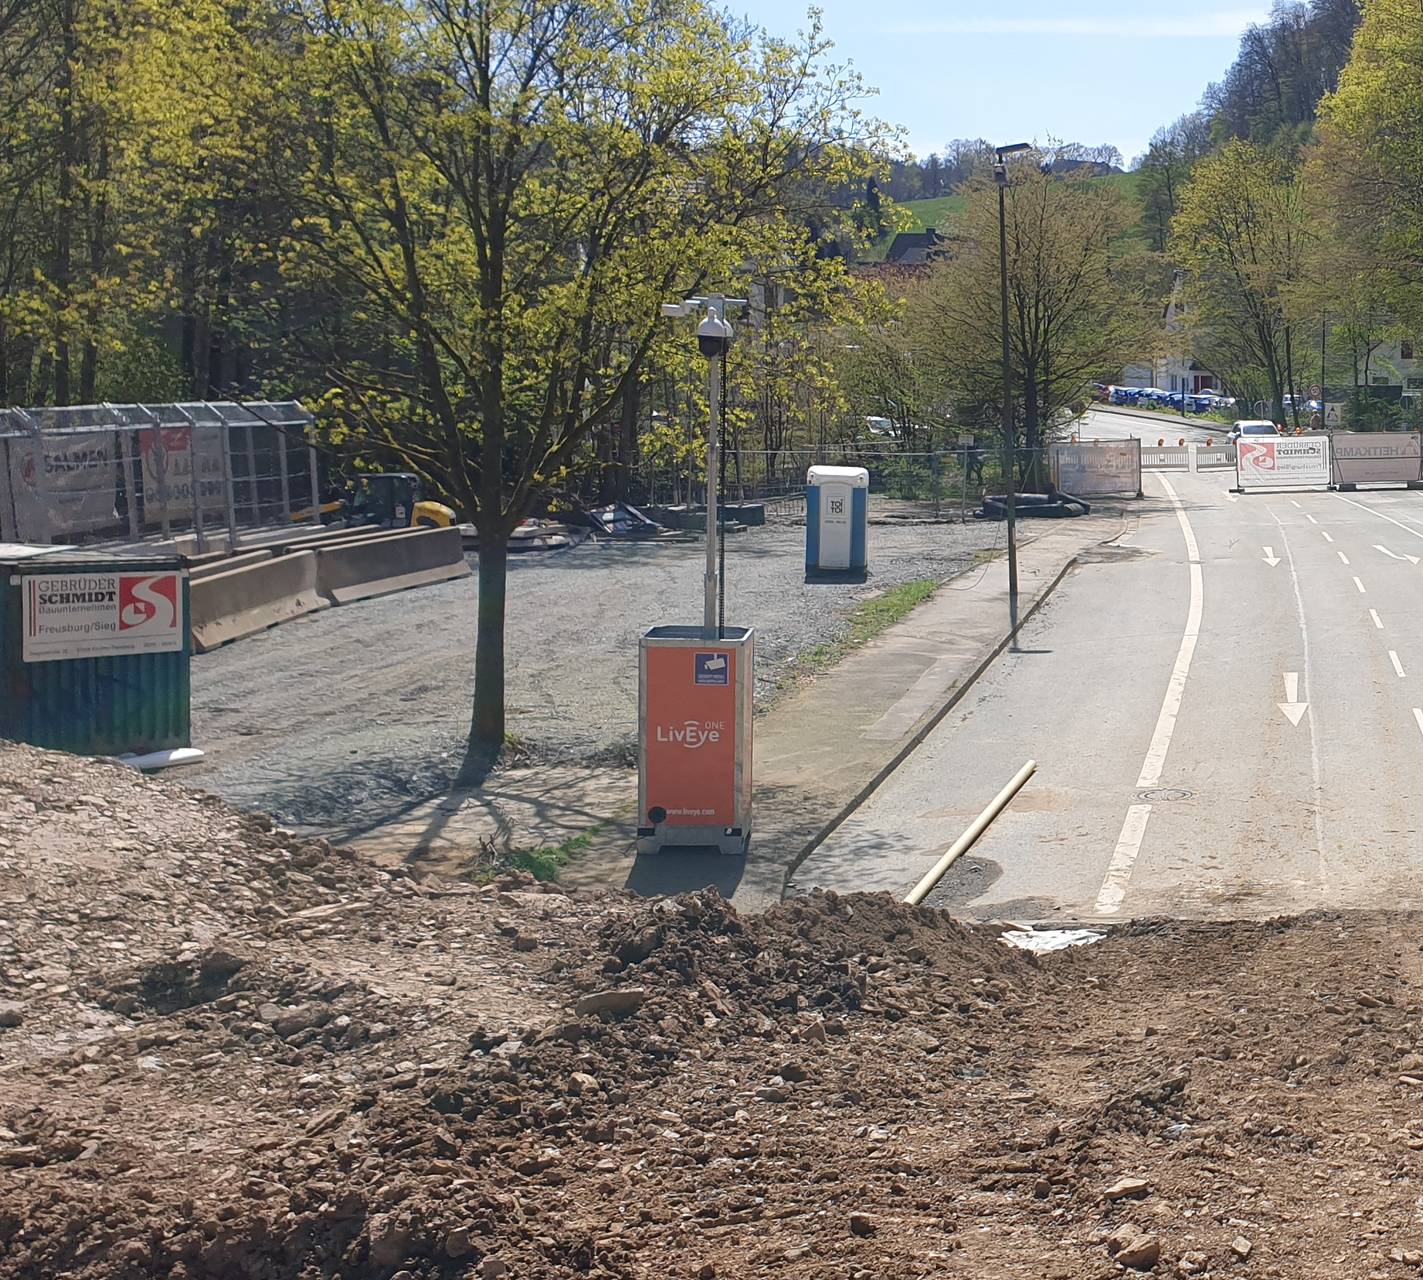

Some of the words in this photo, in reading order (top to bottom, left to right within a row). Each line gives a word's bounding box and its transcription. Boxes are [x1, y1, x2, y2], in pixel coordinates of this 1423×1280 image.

[38, 577, 117, 593] GEBRÜDER
[38, 591, 117, 605] SCHMIDT
[38, 603, 117, 615] Bauunternehmen
[38, 622, 117, 634] Freusburg/Sieg
[704, 721, 725, 730] ONE
[656, 722, 720, 748] LivEye
